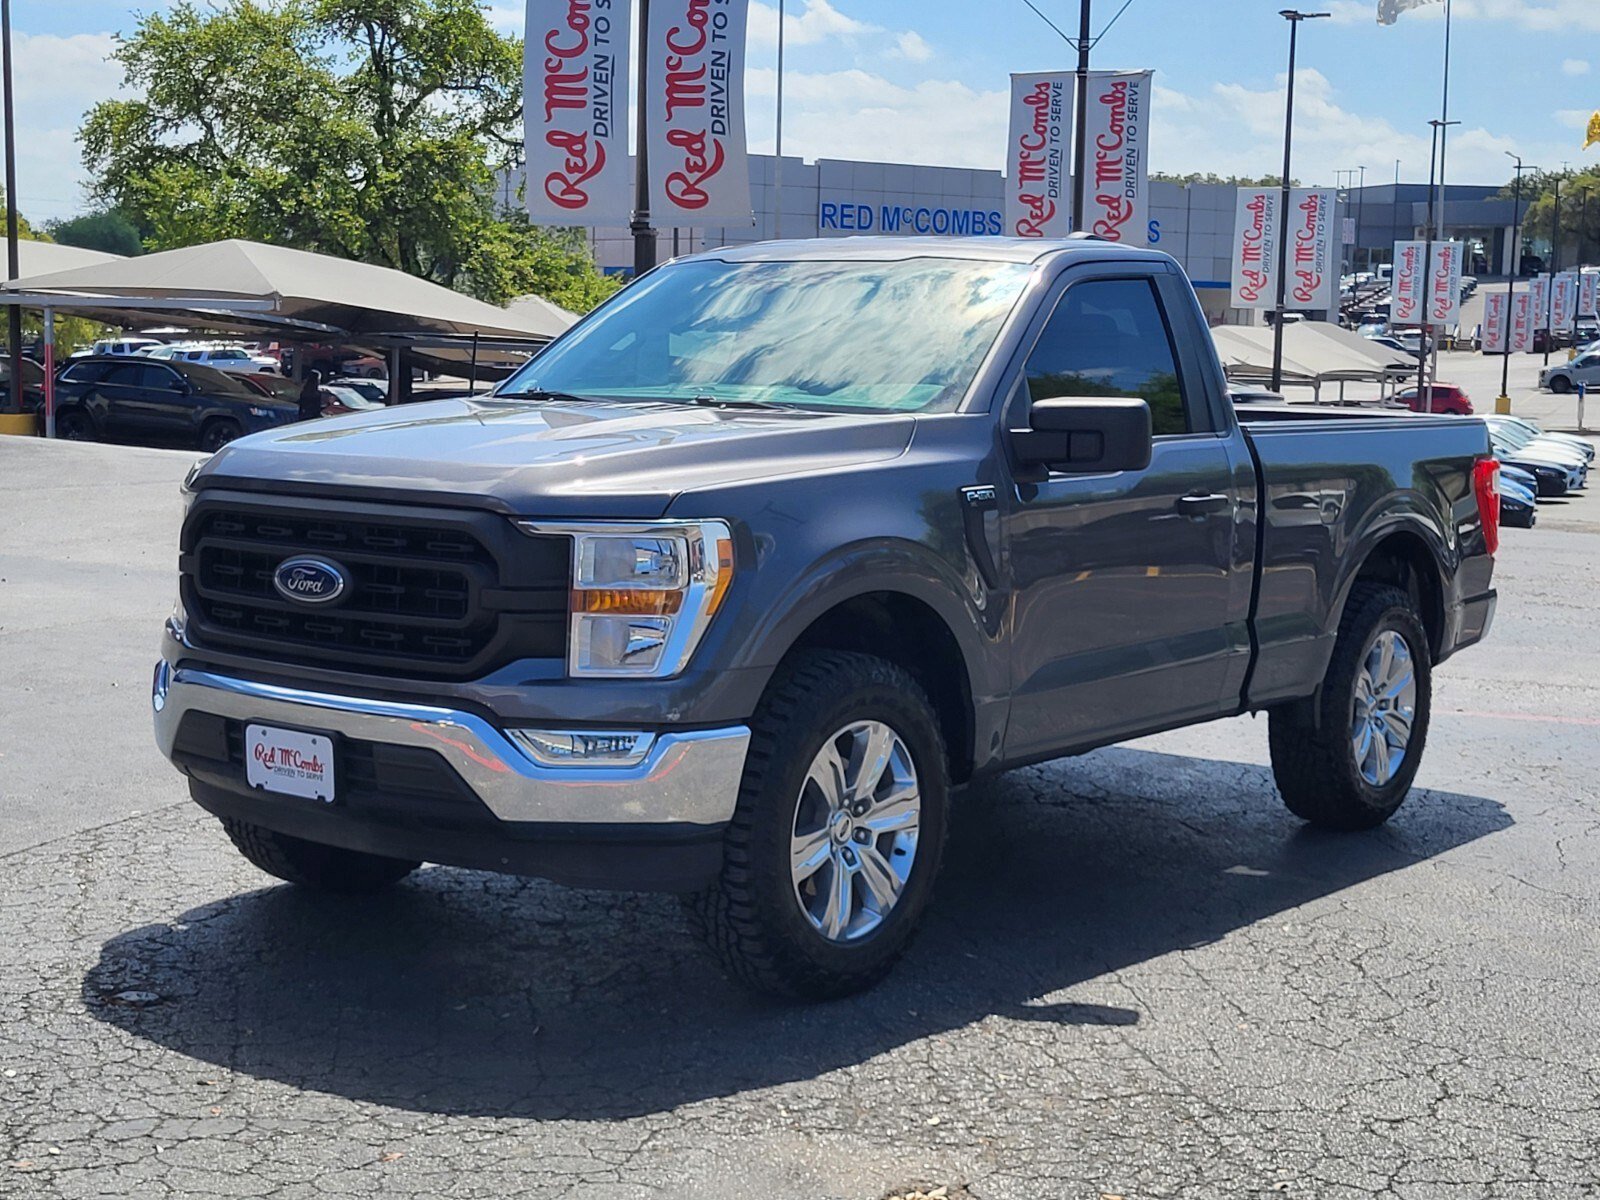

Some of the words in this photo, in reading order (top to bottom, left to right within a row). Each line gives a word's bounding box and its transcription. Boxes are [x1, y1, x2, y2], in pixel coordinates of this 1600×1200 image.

[594, 16, 610, 47] TO
[712, 11, 728, 42] TO
[593, 54, 609, 138] DRIVEN
[710, 50, 726, 136] DRIVEN
[1051, 82, 1063, 122] SERVE
[1127, 81, 1139, 121] SERVE
[1018, 82, 1051, 189] McCombs
[1050, 126, 1061, 145] TO
[1095, 81, 1127, 190] McCombs
[1126, 125, 1137, 144] TO
[545, 130, 606, 209] Red
[665, 129, 725, 209] Red
[1048, 149, 1060, 198] DRIVEN
[1125, 149, 1136, 198] DRIVEN
[821, 203, 873, 230] RED
[1016, 194, 1056, 237] Red
[1093, 194, 1133, 242] Red
[1264, 194, 1274, 222] SERVE
[1318, 194, 1328, 222] SERVE
[1242, 194, 1265, 265] McCombs
[1265, 224, 1272, 236] TO
[1295, 194, 1318, 265] McCombs
[1317, 224, 1325, 236] TO
[1316, 240, 1324, 273] DRIVEN
[1239, 270, 1268, 301] Red
[1293, 270, 1321, 302] Red
[288, 568, 325, 593] Ford
[254, 743, 275, 769] Red
[277, 747, 324, 773] McCombs
[273, 766, 296, 777] DRIVEN
[297, 770, 305, 778] TO
[306, 772, 323, 781] SERVE
